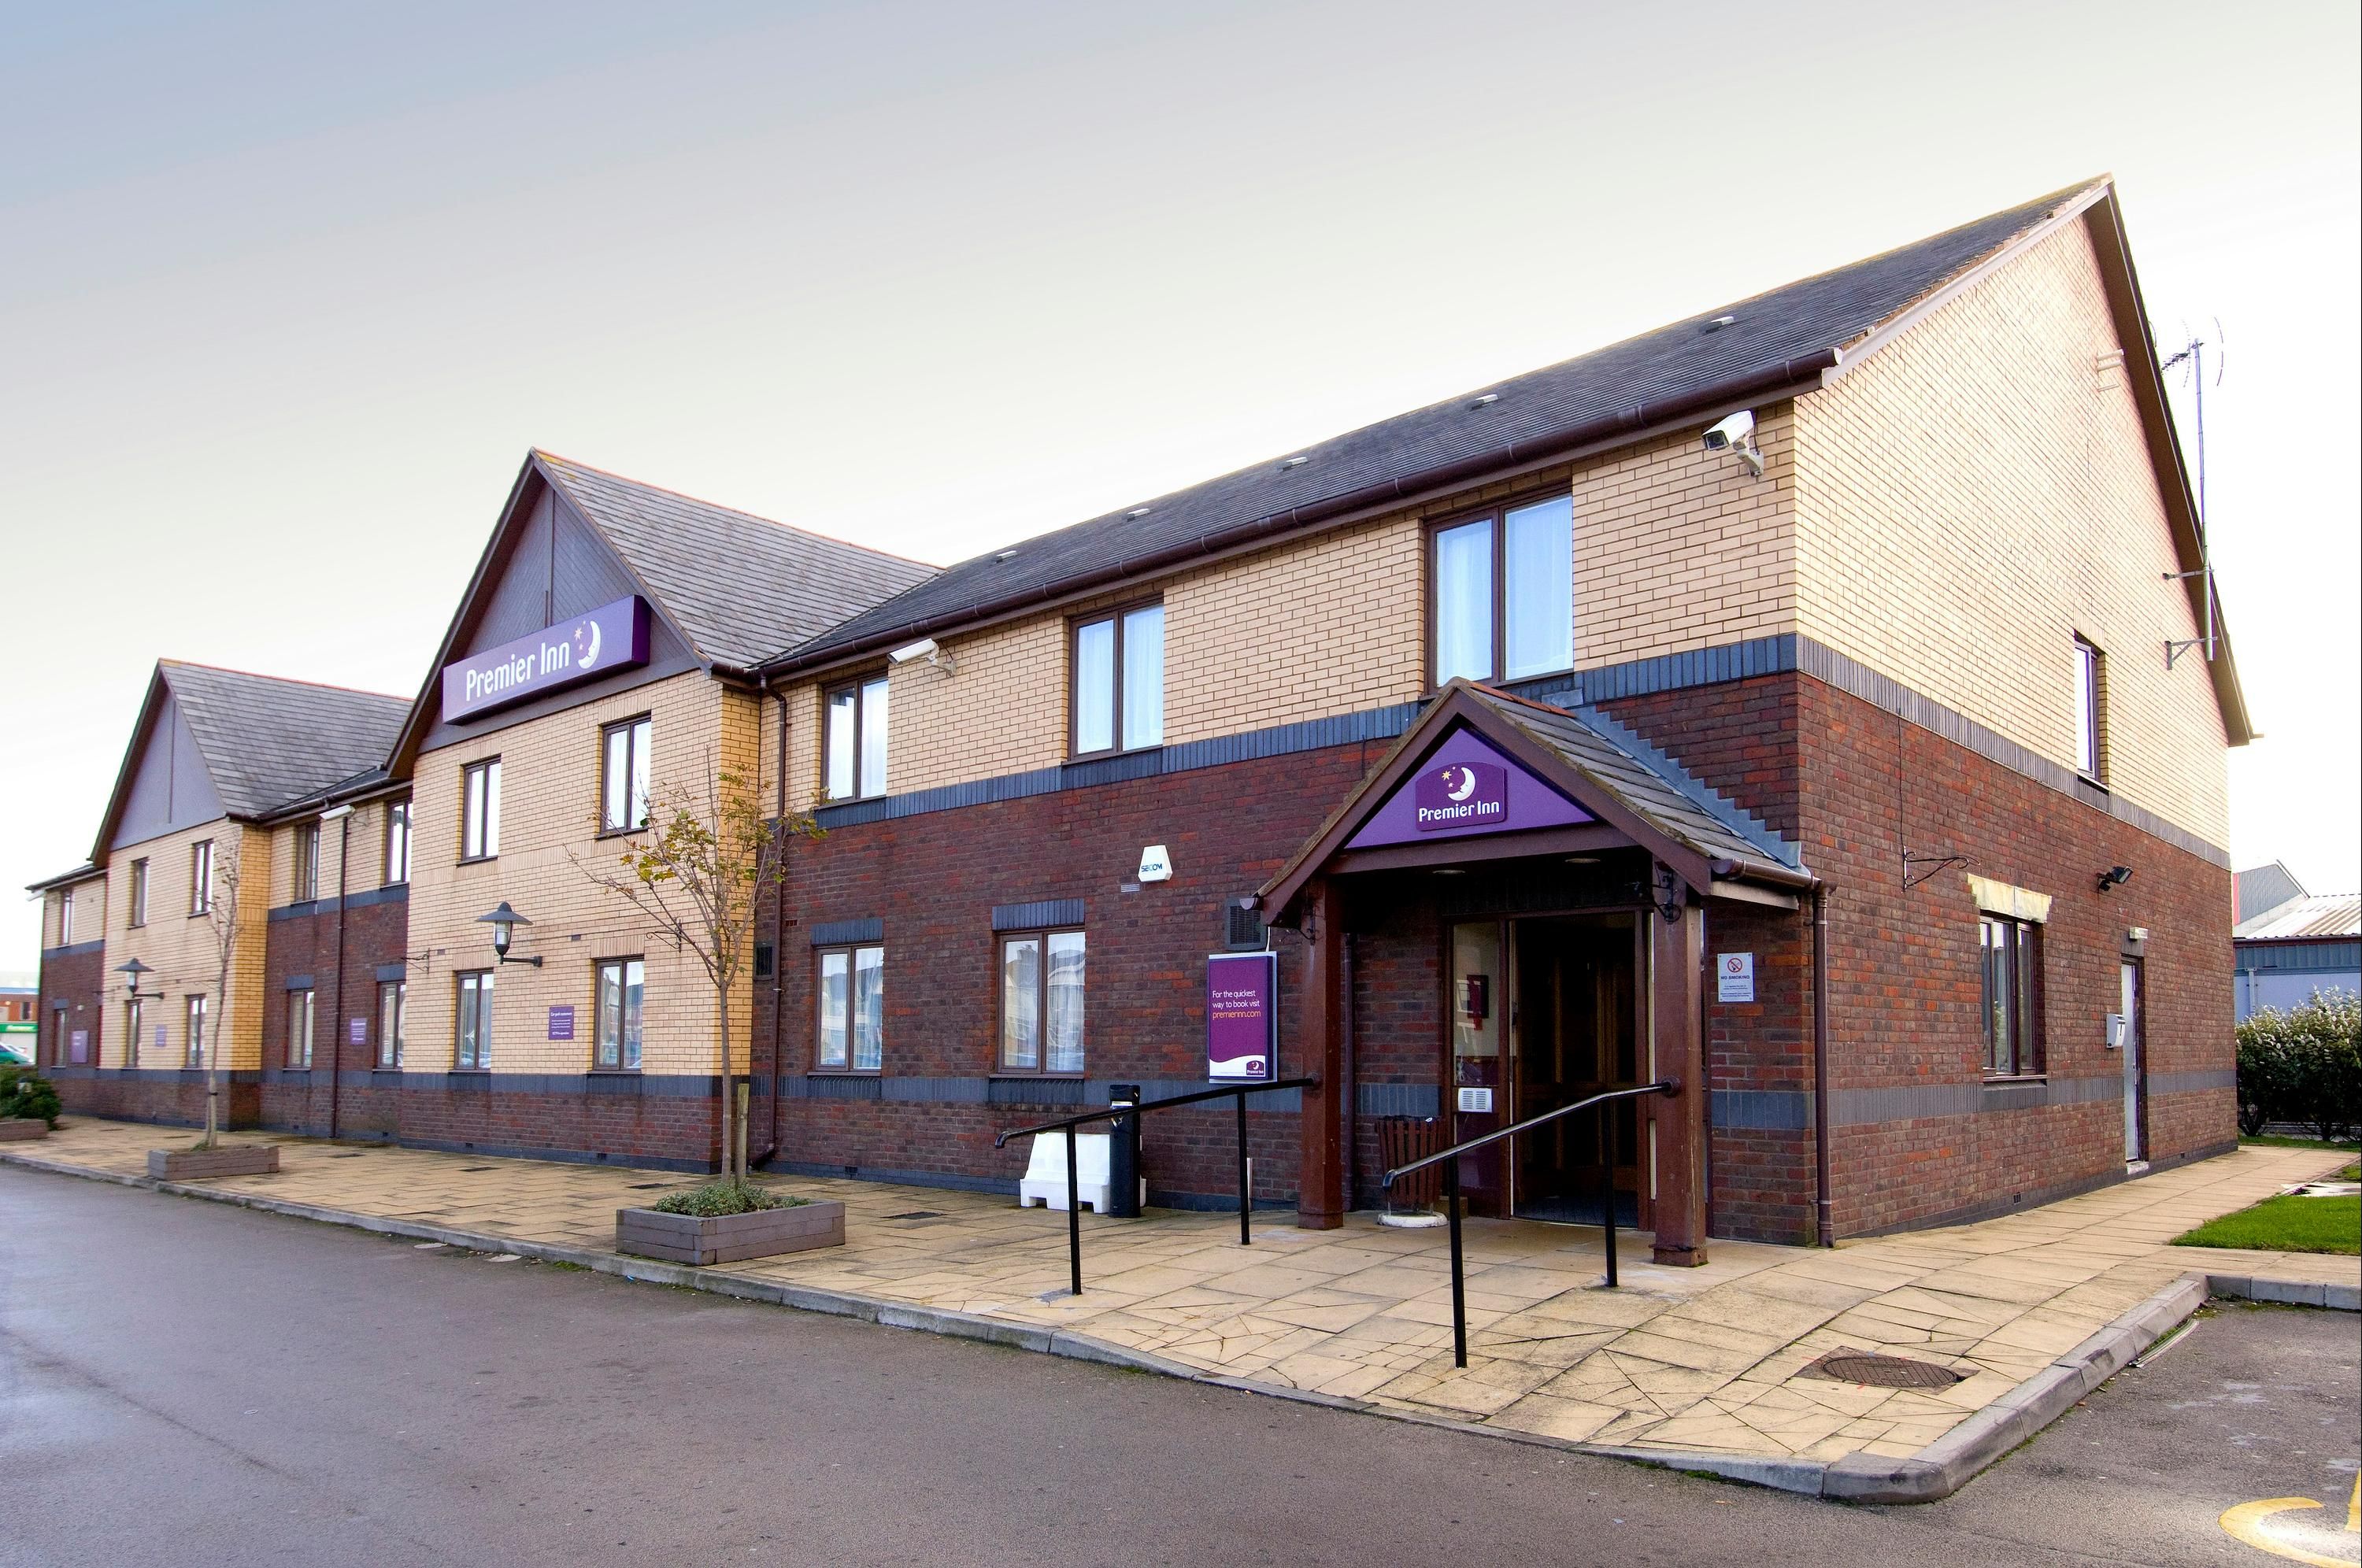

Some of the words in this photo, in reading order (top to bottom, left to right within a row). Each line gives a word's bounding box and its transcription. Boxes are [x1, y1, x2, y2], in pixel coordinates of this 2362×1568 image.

[465, 653, 536, 701] Premier
[540, 642, 570, 675] Inn
[1418, 803, 1475, 823] Premier
[1477, 800, 1500, 815] Inn
[1141, 863, 1163, 872] SECOM
[1233, 989, 1256, 999] quickest
[1212, 1010, 1261, 1020] premierinn.com
